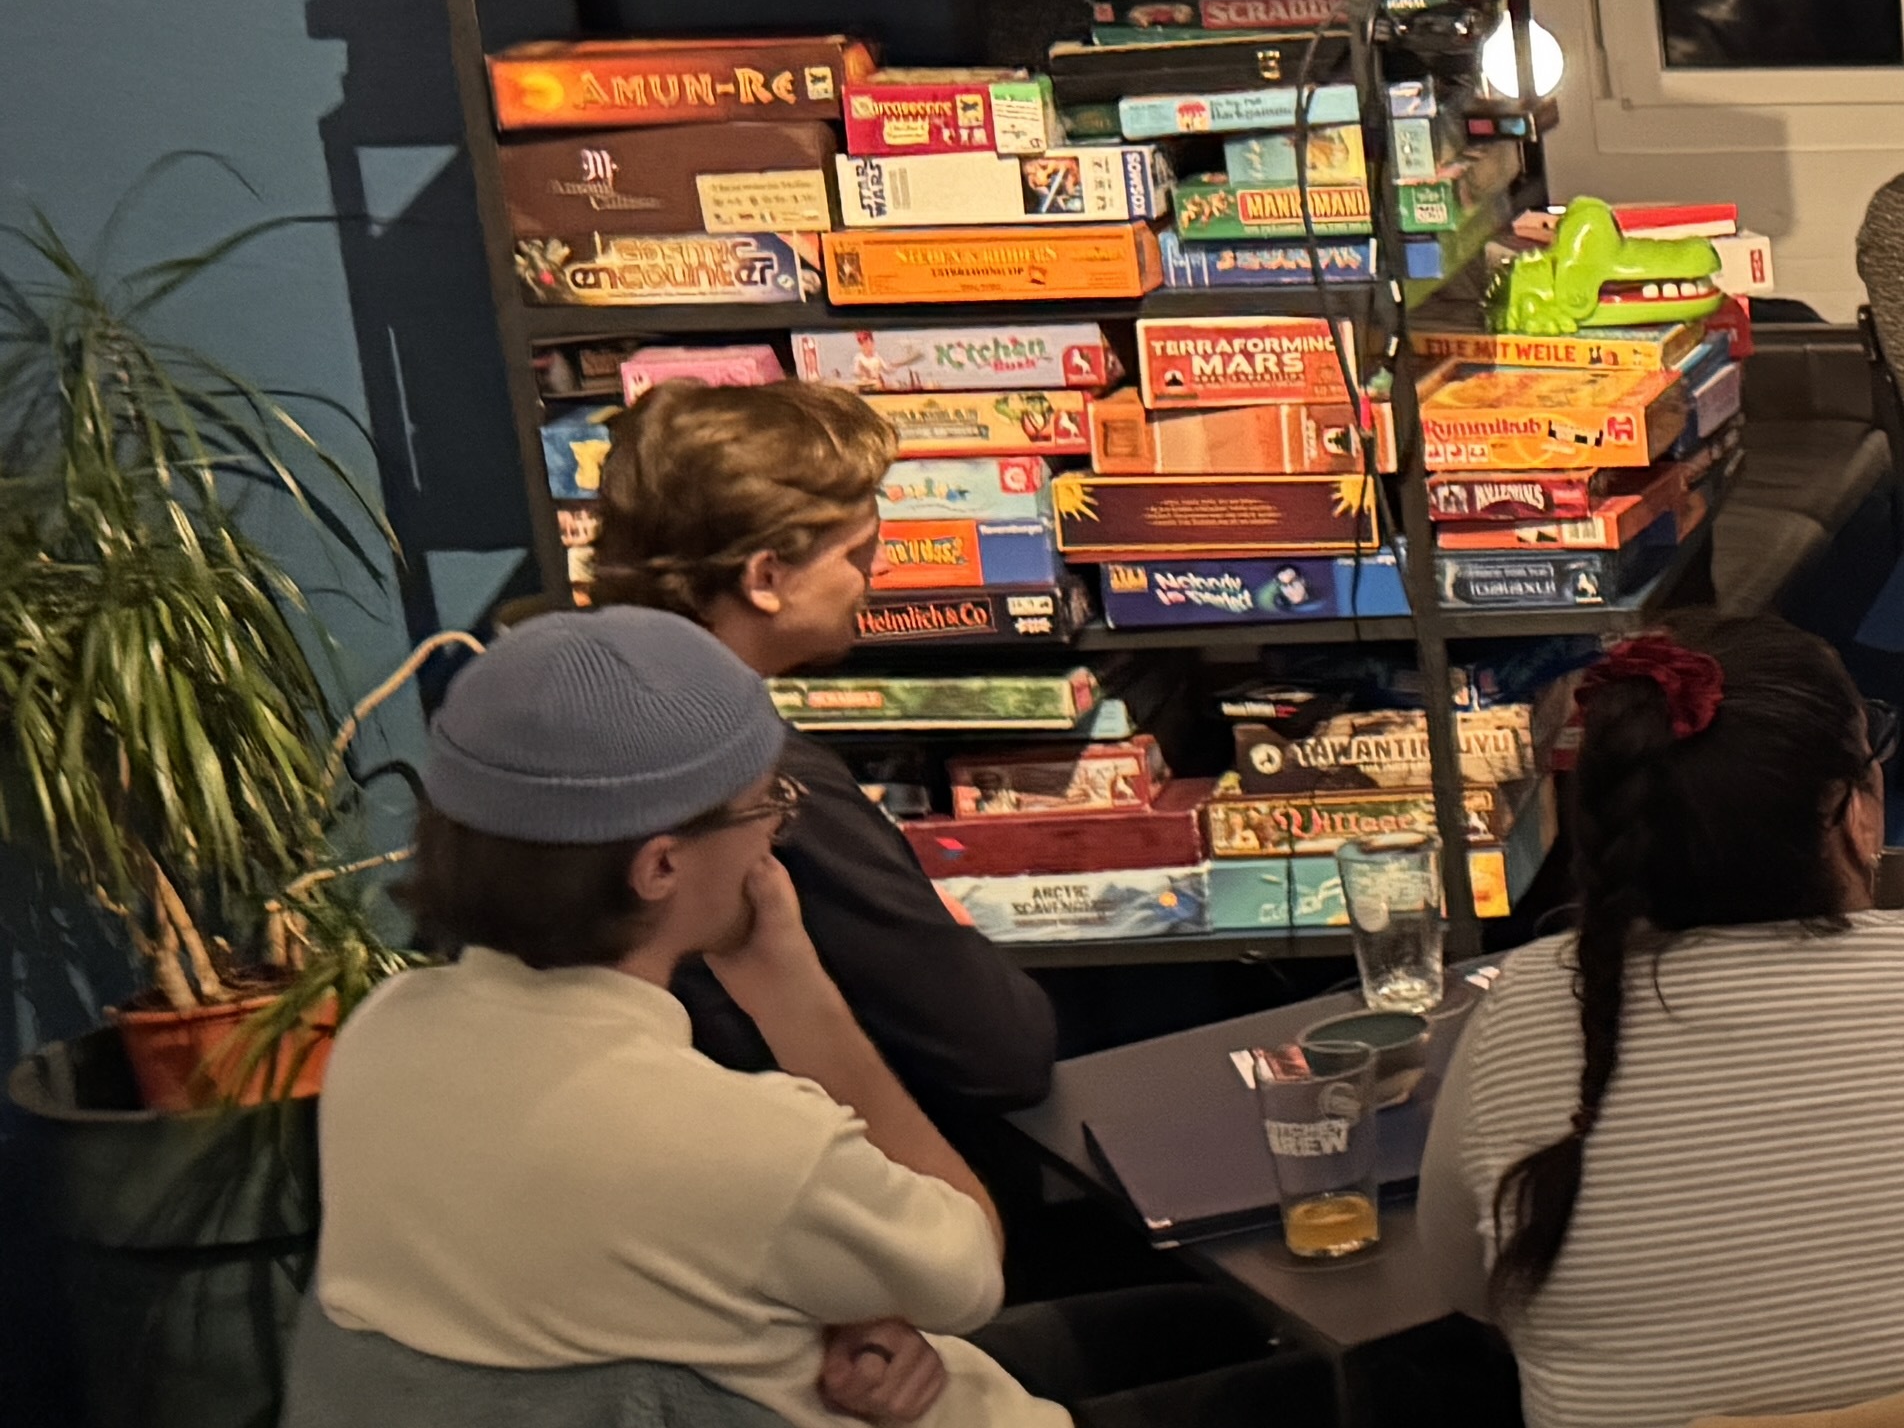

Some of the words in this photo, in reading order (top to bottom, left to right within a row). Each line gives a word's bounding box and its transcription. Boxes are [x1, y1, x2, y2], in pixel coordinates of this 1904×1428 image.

[870, 163, 888, 217] WARS
[1125, 152, 1147, 217] KOSMOS
[934, 337, 1047, 370] Kitchen
[1150, 335, 1337, 357] TERRAFORMING
[1424, 338, 1470, 357] EILE
[1473, 339, 1511, 359] MIT
[1514, 341, 1577, 363] WEILE
[1191, 352, 1305, 376] MARS
[1423, 417, 1542, 443] Rummikub
[960, 601, 989, 628] Co
